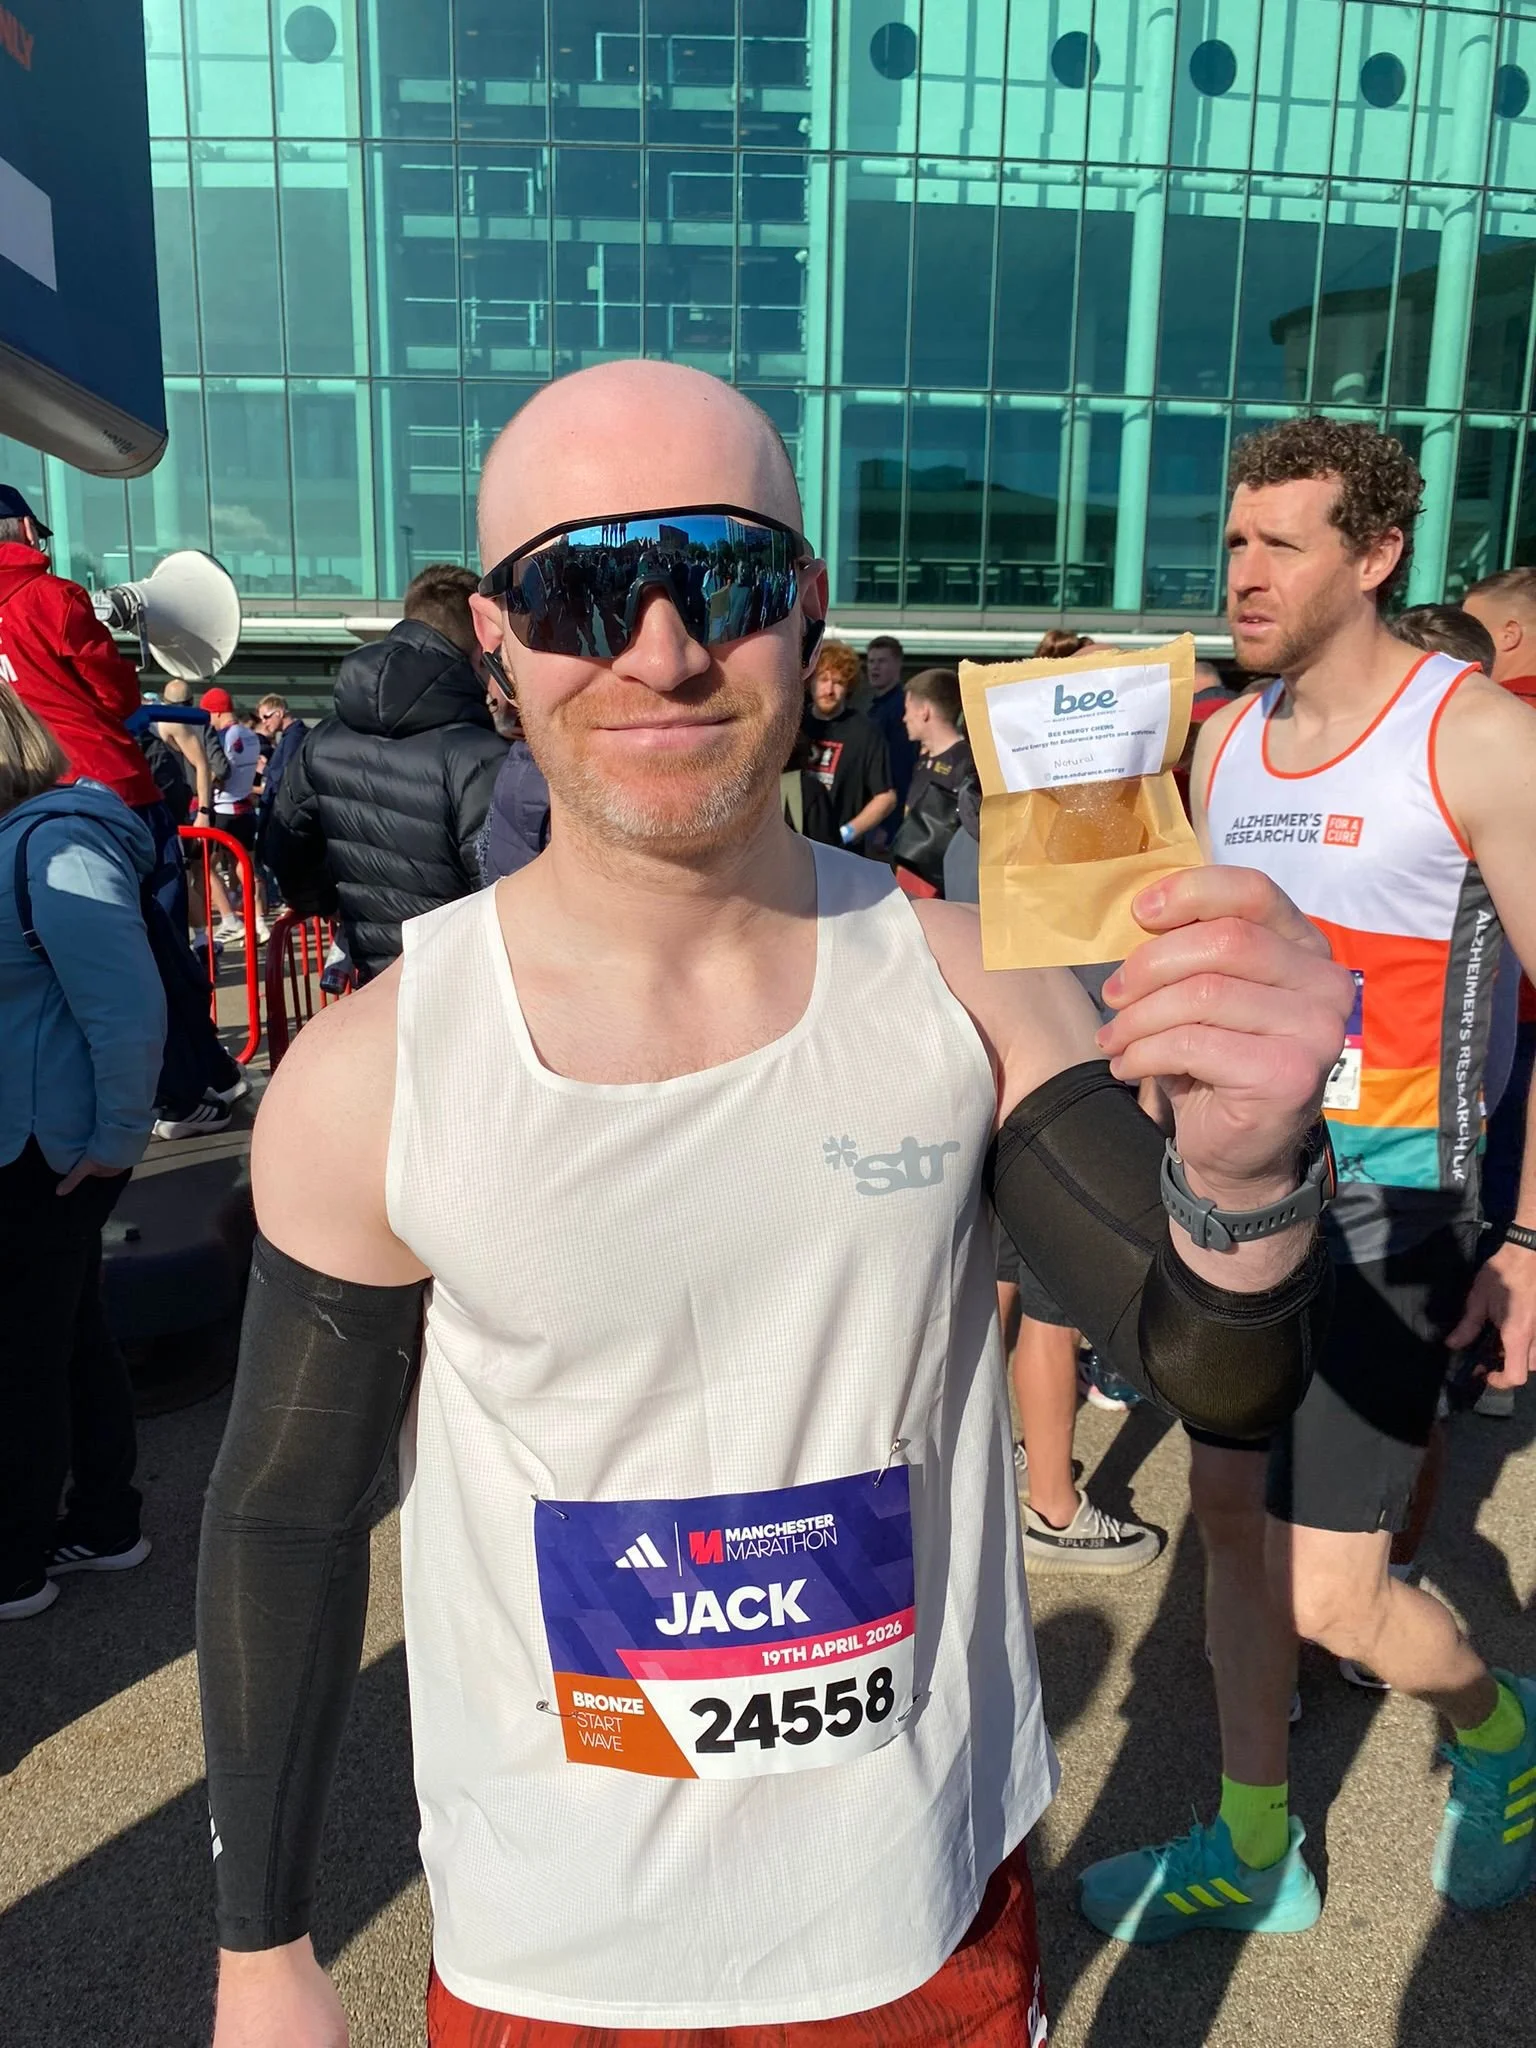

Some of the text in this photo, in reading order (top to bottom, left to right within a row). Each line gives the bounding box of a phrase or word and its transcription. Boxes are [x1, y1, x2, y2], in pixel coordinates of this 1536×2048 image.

[1054, 684, 1118, 715] bee
[1060, 735, 1094, 744] Endurance
[1095, 732, 1115, 741] sports
[1062, 727, 1089, 736] ENERGY
[1091, 724, 1114, 732] CHEWS
[1054, 754, 1094, 769] Natural
[1232, 813, 1323, 830] ALZHEIMER'S
[1330, 817, 1359, 830] FOR A
[1224, 829, 1319, 846] RESEARCH UK
[1327, 829, 1357, 843] CURE
[1451, 909, 1492, 1182] ALZHEIMER'S RESEARCH UK
[725, 1513, 835, 1542] MANCHESTER
[726, 1528, 837, 1561] MARATHON
[655, 1578, 811, 1636] JACK
[762, 1623, 903, 1666] 19TH APRIL 2026
[572, 1690, 645, 1716] BRONZE
[689, 1666, 895, 1754] 24558
[576, 1714, 623, 1733] START
[580, 1731, 624, 1752] WAVE
